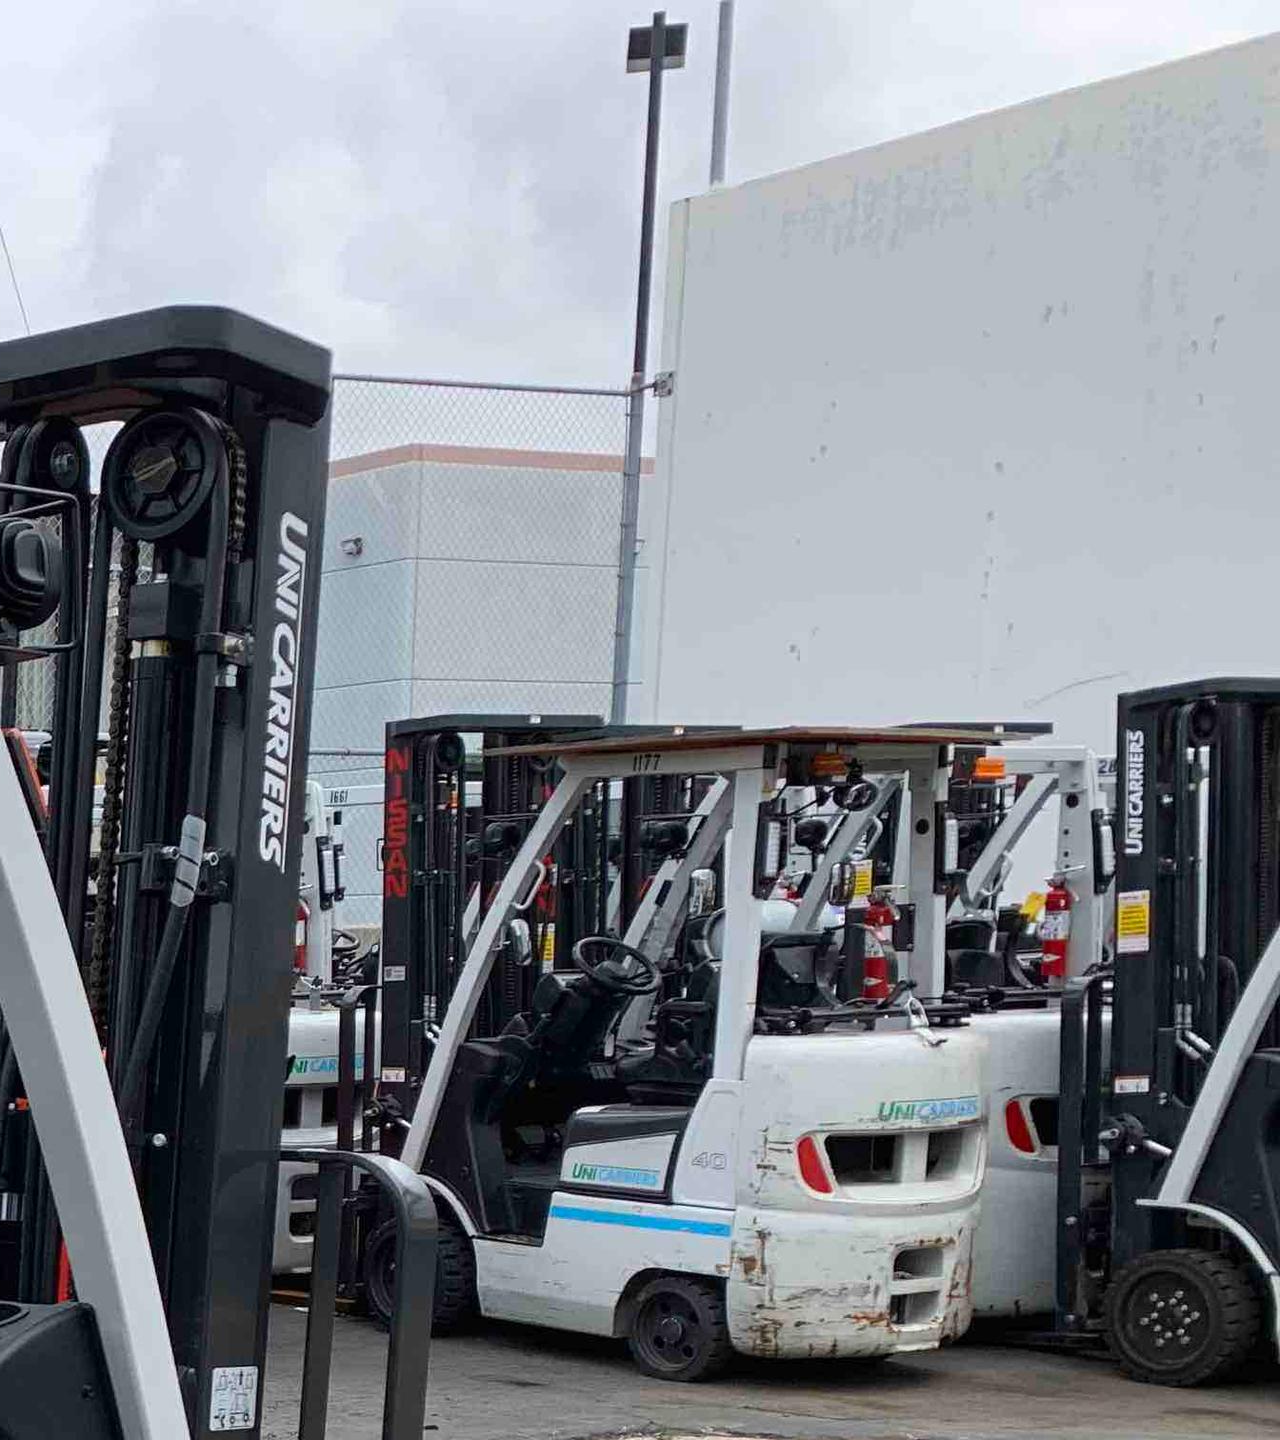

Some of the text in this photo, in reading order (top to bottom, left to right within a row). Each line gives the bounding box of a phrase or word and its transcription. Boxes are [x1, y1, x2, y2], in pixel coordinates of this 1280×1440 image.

[260, 511, 308, 873] UNICARRIERS
[386, 748, 409, 897] NISSAN
[632, 753, 661, 771] 1177
[1125, 729, 1144, 854] UNICARRIERS
[692, 1151, 728, 1171] 40
